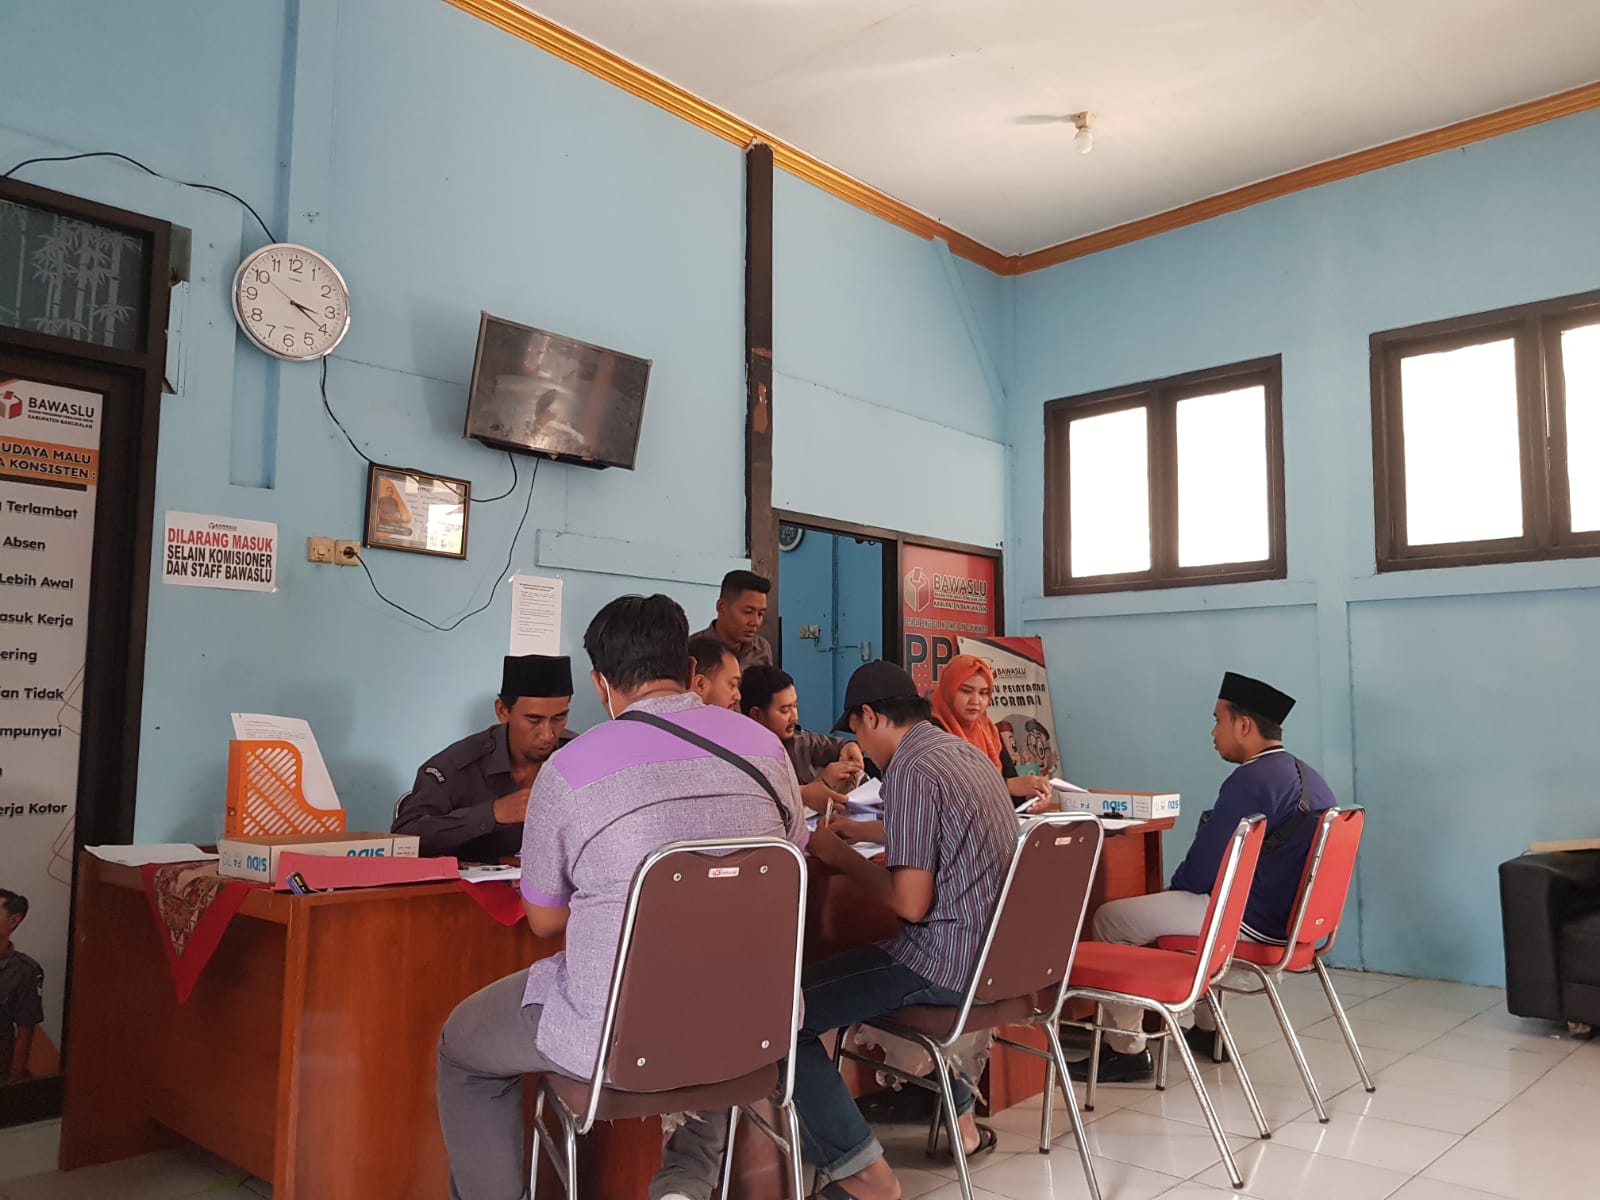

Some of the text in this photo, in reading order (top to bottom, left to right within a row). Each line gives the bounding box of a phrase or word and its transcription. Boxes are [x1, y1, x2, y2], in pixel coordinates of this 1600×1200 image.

[272, 258, 281, 272] 11
[288, 258, 303, 273] 12
[254, 269, 270, 284] 10
[311, 268, 316, 281] 1
[246, 286, 258, 300] 9
[321, 284, 332, 298] 2
[251, 307, 263, 321] 8
[325, 306, 336, 320] 3
[265, 324, 276, 338] 7
[318, 323, 329, 336] 4
[282, 333, 295, 348] 6
[303, 332, 315, 346] 5
[29, 396, 94, 418] BAWASLU
[53, 448, 91, 465] MALU
[10, 459, 89, 479] KONSISTEN
[6, 500, 78, 519] Terlambat
[3, 536, 46, 550] Absen
[167, 527, 273, 552] DILARANG MASUK
[167, 544, 272, 569] SELAIN KOMISIONER
[166, 559, 272, 583] DAN STAFF BAWASLU
[0, 573, 73, 589] Lebih Awal
[933, 574, 987, 597] BAWASLU
[38, 613, 73, 628] Kerja
[997, 667, 1026, 675] BAWASLU
[24, 687, 64, 699] Tidak
[29, 802, 68, 814] Kotor
